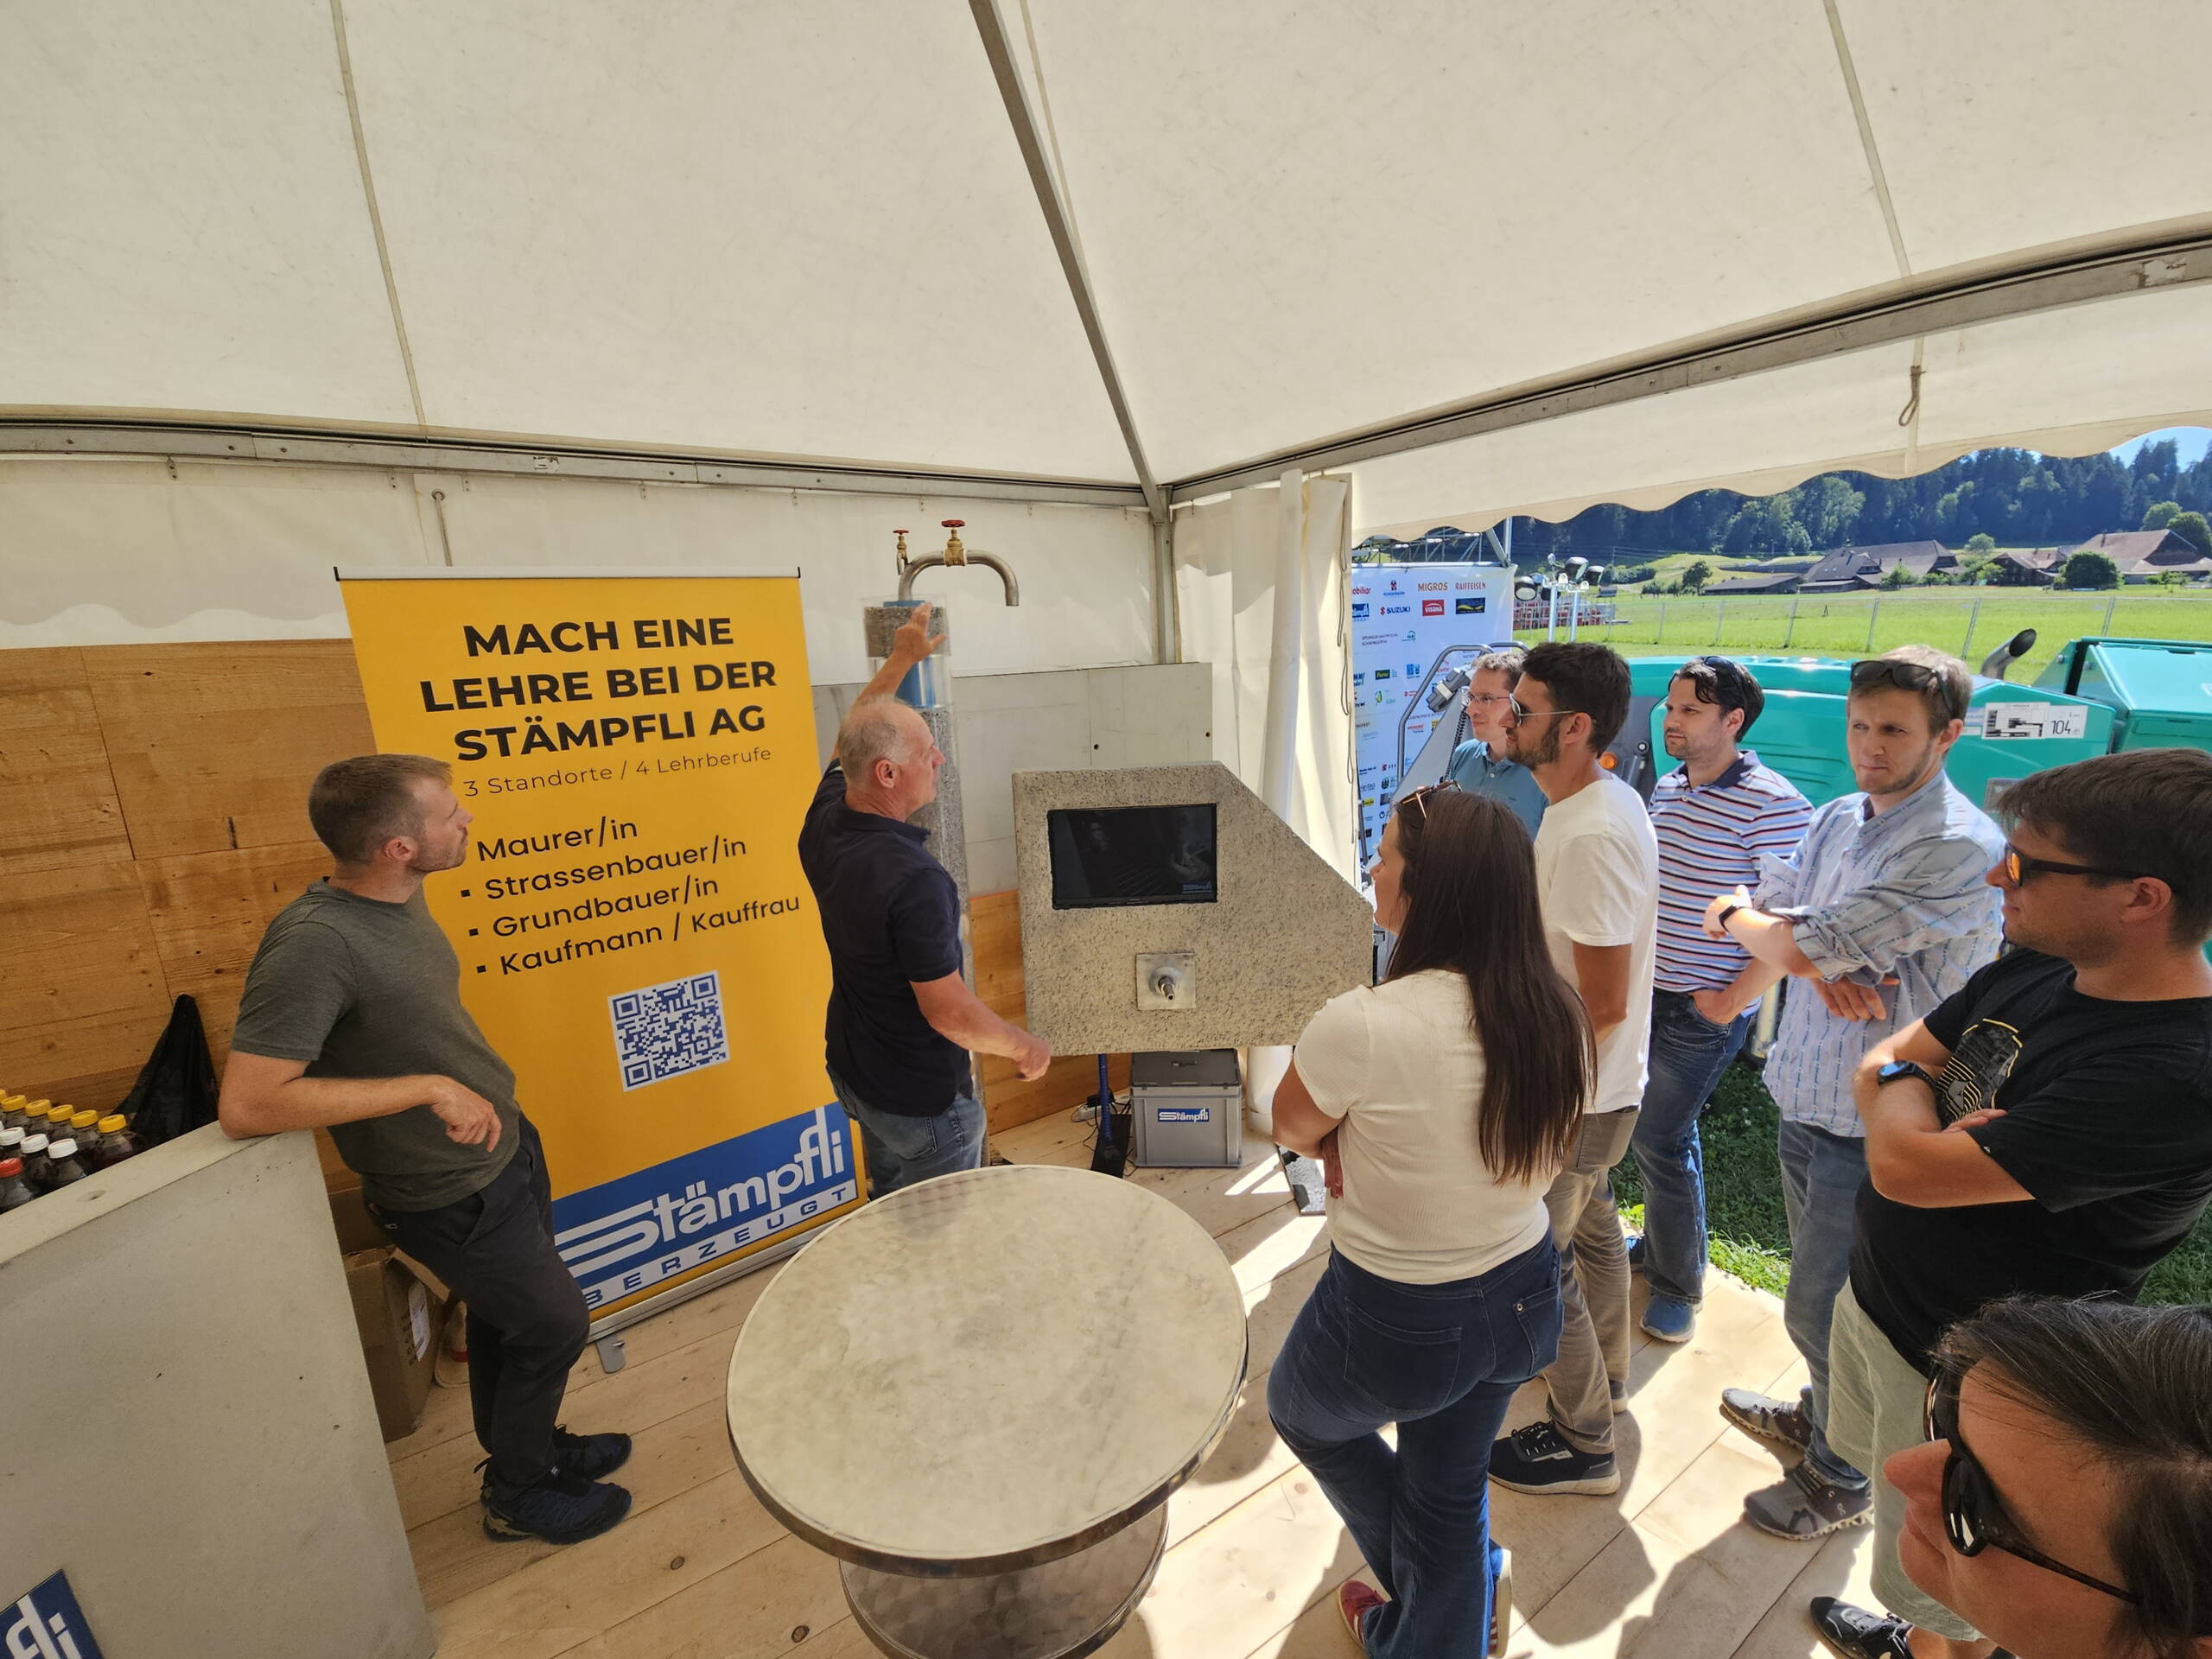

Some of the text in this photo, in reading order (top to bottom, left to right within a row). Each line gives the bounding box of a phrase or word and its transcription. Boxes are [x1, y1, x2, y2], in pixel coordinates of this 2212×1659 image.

[1351, 586, 1371, 595] obiliar
[1418, 582, 1448, 591] MIGROS
[1455, 582, 1486, 590] RAIFFEISEN
[463, 618, 734, 657] MACH EINE
[419, 660, 777, 712] LEHRE BEI DER
[454, 705, 766, 761] STÄMPFLI AG
[2050, 720, 2071, 734] 104
[464, 780, 479, 798] 3
[488, 763, 613, 795] Standorte
[636, 760, 649, 776] 4
[658, 747, 772, 774] Lehrberufe
[477, 816, 639, 862] Maurer/in
[484, 835, 747, 900] Strassenbauer/in
[493, 875, 719, 938] Grundbauer/in
[500, 925, 663, 976] Kaufmann
[691, 895, 800, 933] Kauffrau
[1159, 1108, 1209, 1122] Stämpfli
[554, 1105, 844, 1278] Stämpfli
[582, 1187, 846, 1306] BERZEUGT
